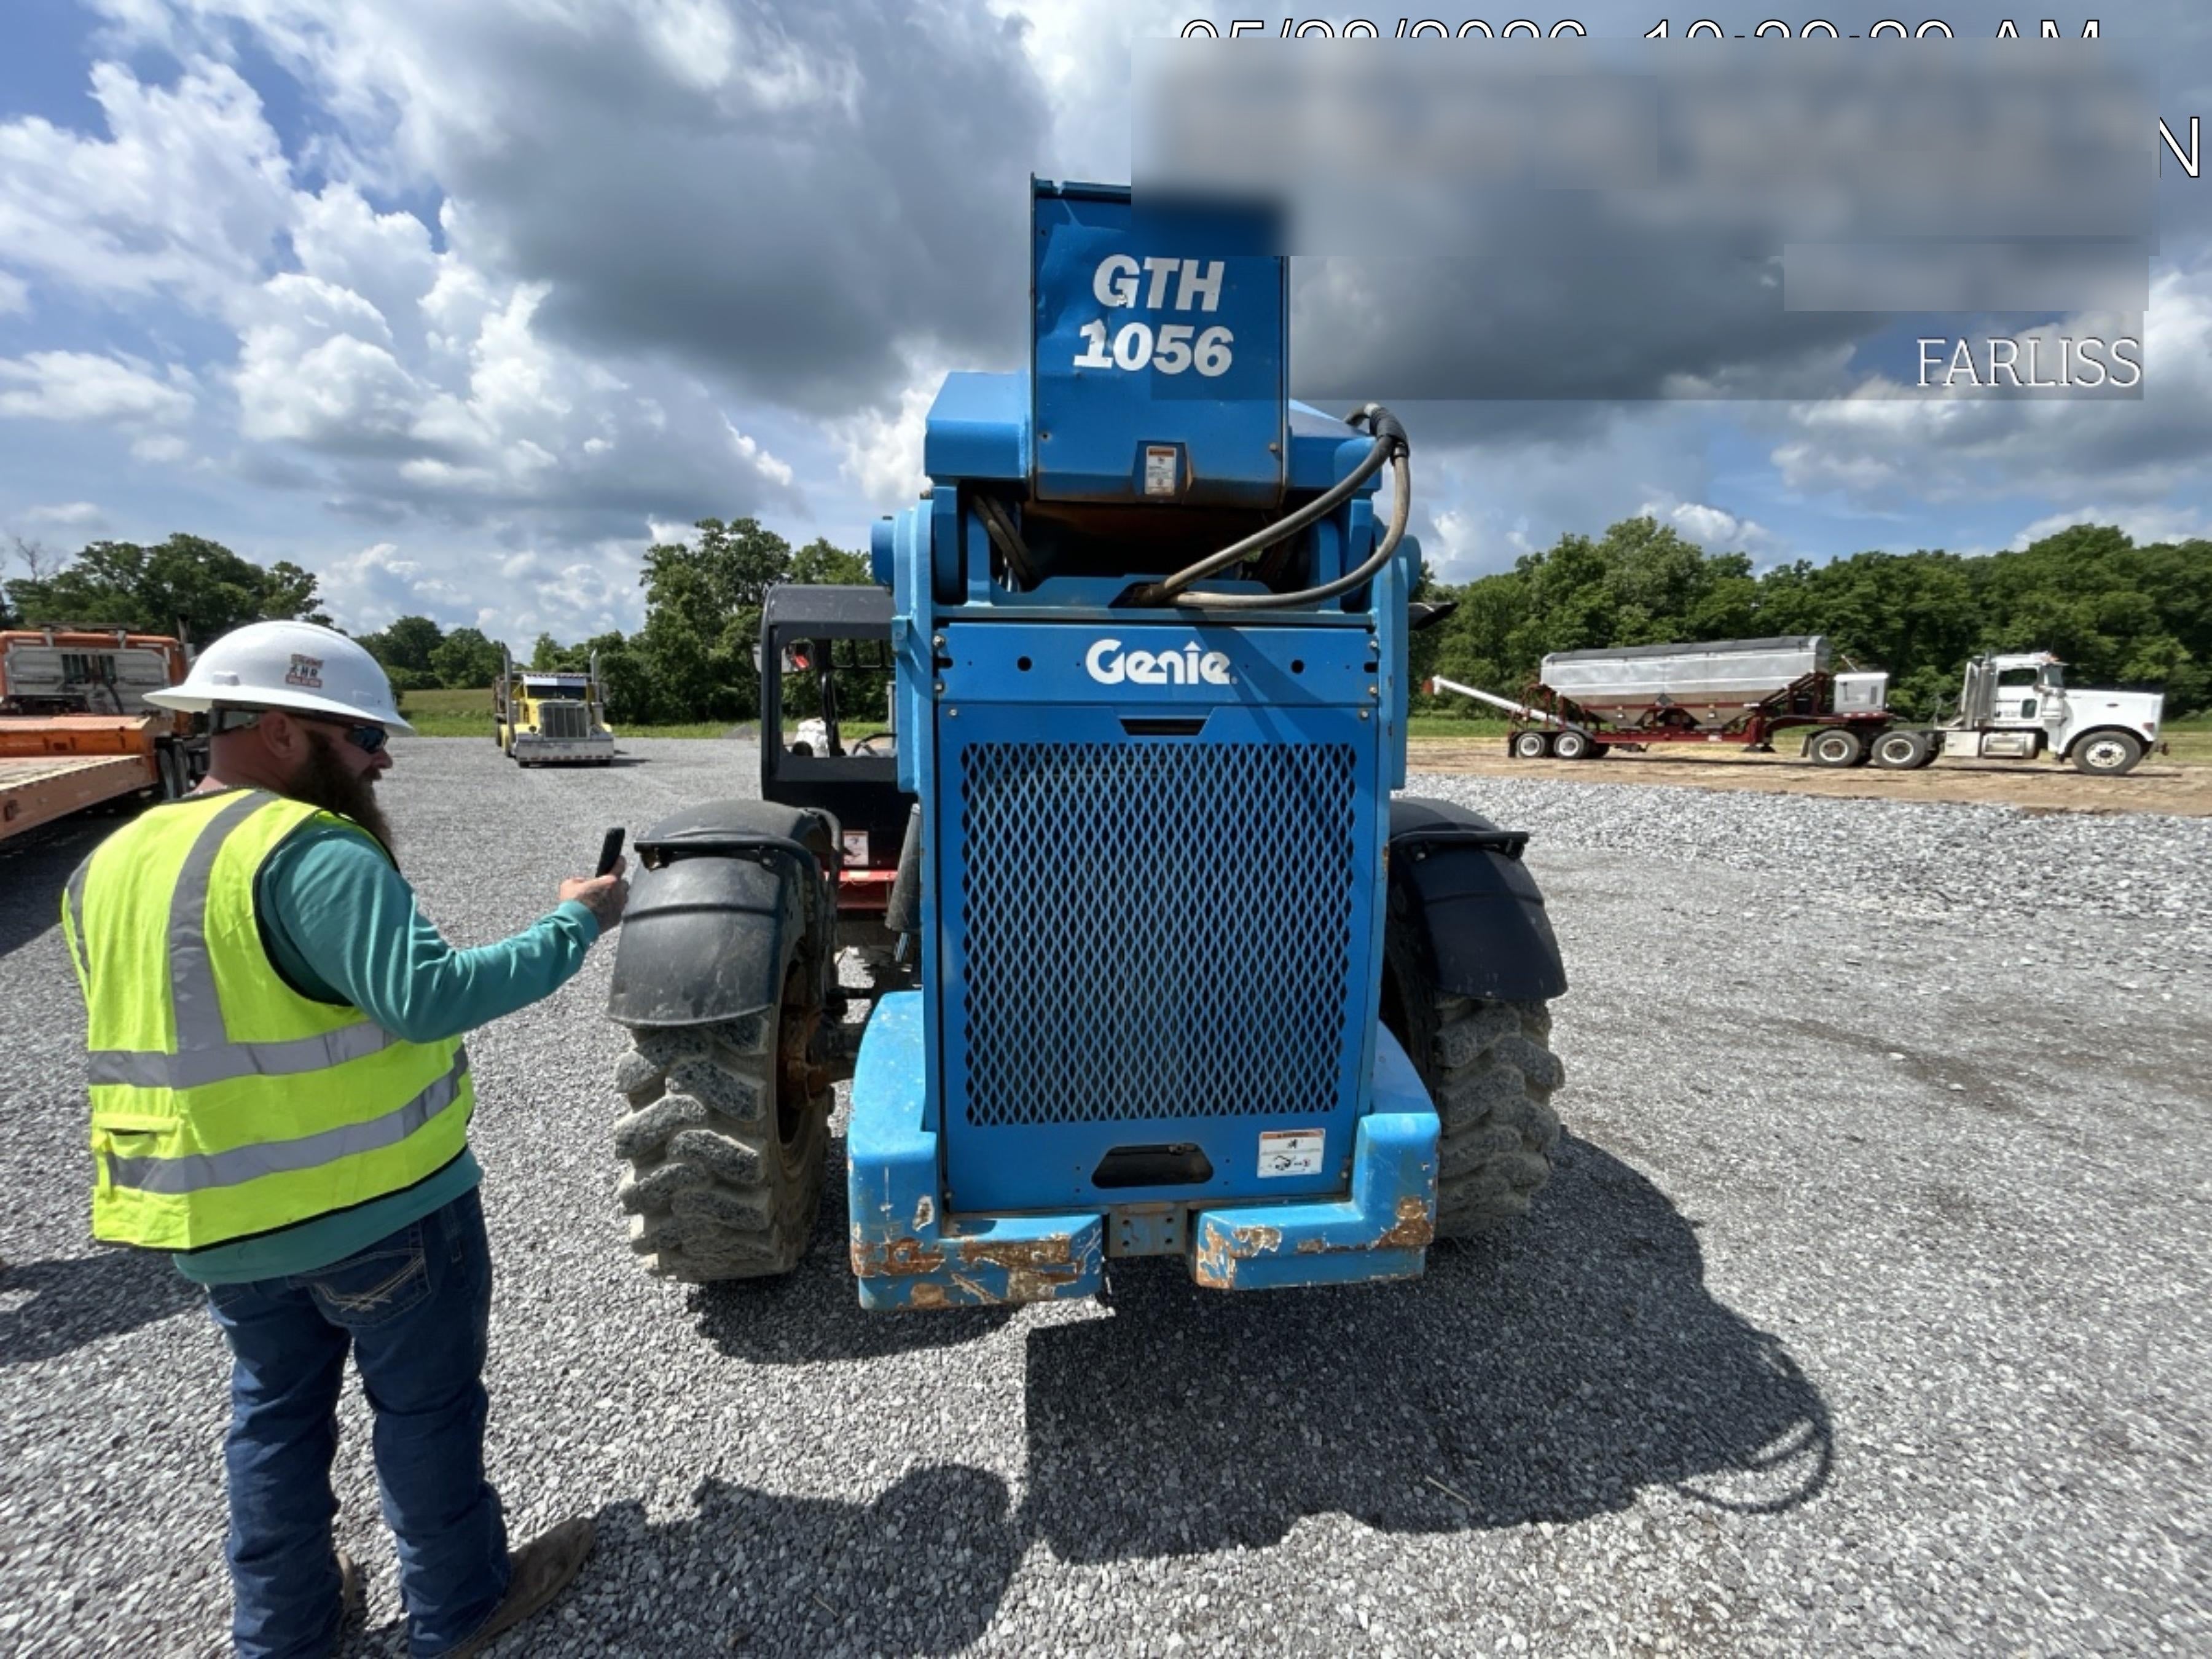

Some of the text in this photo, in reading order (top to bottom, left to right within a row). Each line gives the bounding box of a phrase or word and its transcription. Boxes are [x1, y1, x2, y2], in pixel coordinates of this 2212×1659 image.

[1092, 254, 1225, 312] GTH
[1073, 319, 1234, 377] 1056
[1085, 638, 1231, 684] Genie
